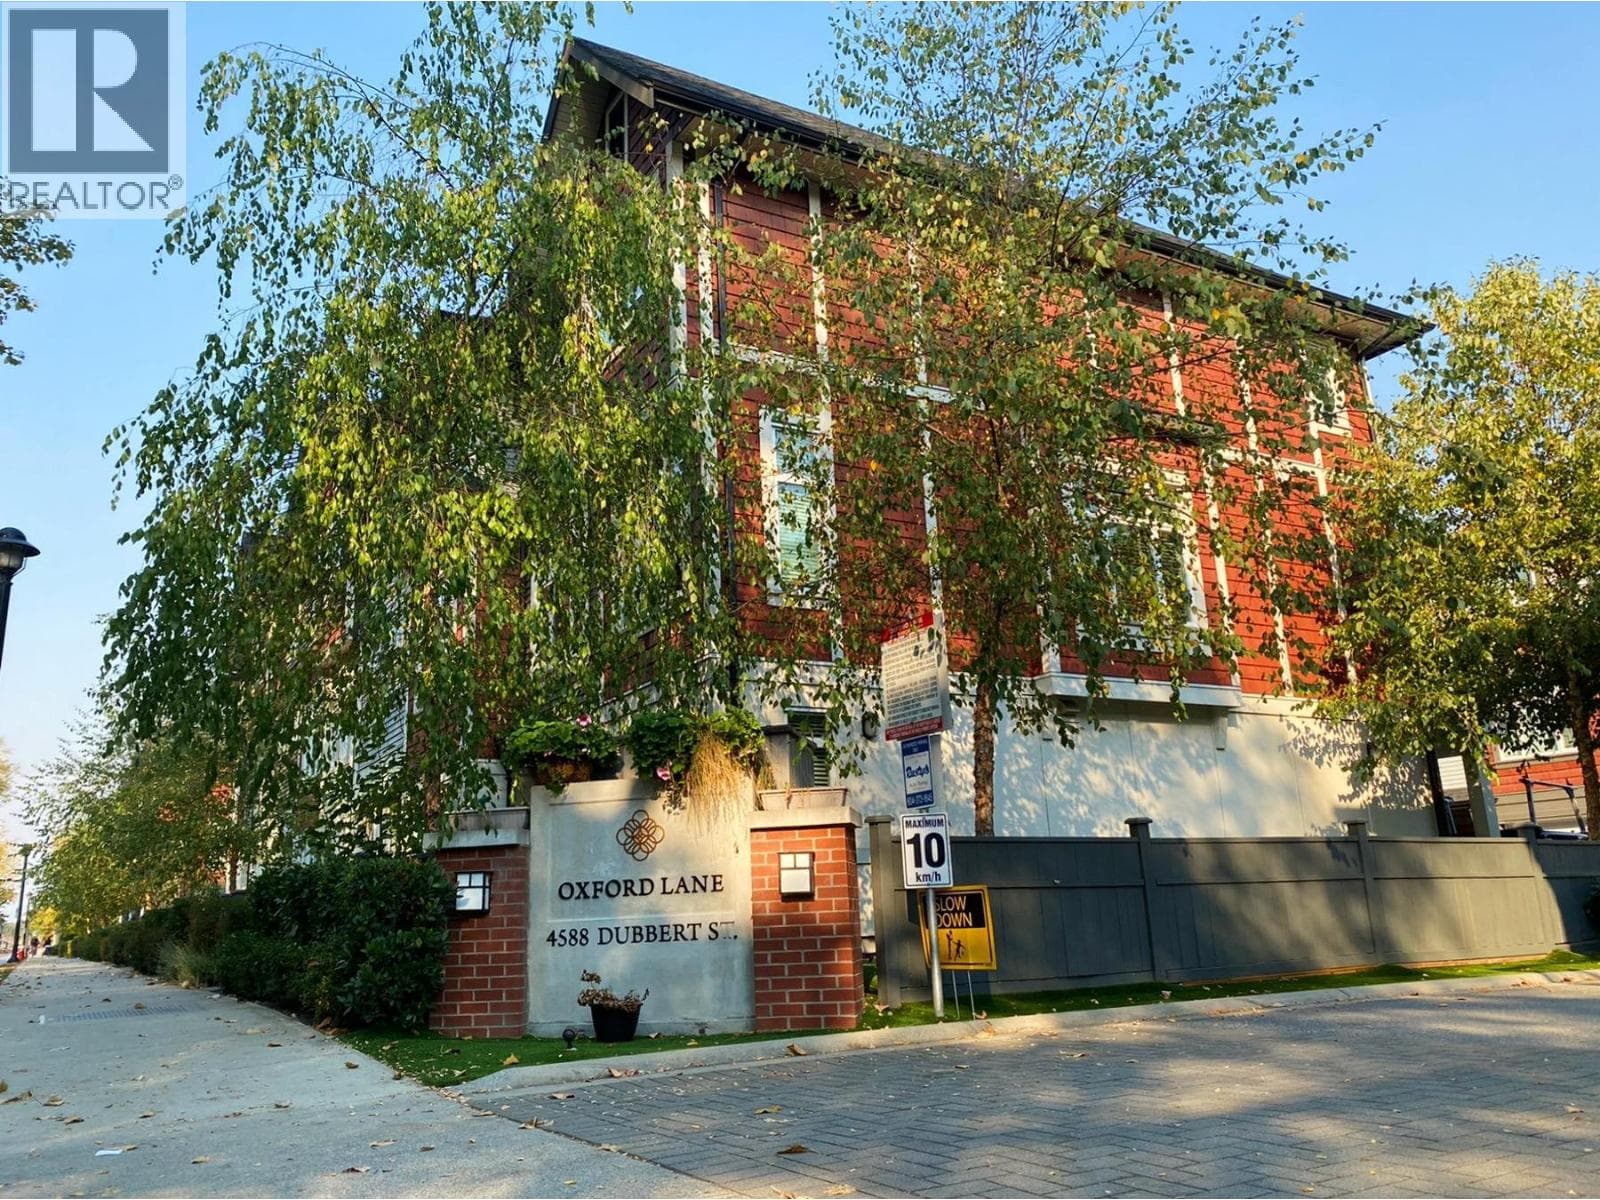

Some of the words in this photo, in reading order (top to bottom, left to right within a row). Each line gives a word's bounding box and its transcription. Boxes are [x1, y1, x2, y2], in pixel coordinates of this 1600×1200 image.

[905, 818, 944, 829] MAXIMUM
[906, 832, 946, 869] 10
[915, 871, 942, 883] km/h
[558, 878, 655, 900] OXFORD
[660, 874, 724, 895] LANE
[935, 895, 967, 912] SLOW
[936, 911, 973, 928] DOWN
[546, 927, 590, 947] 4588
[597, 922, 702, 945] DUBBERT
